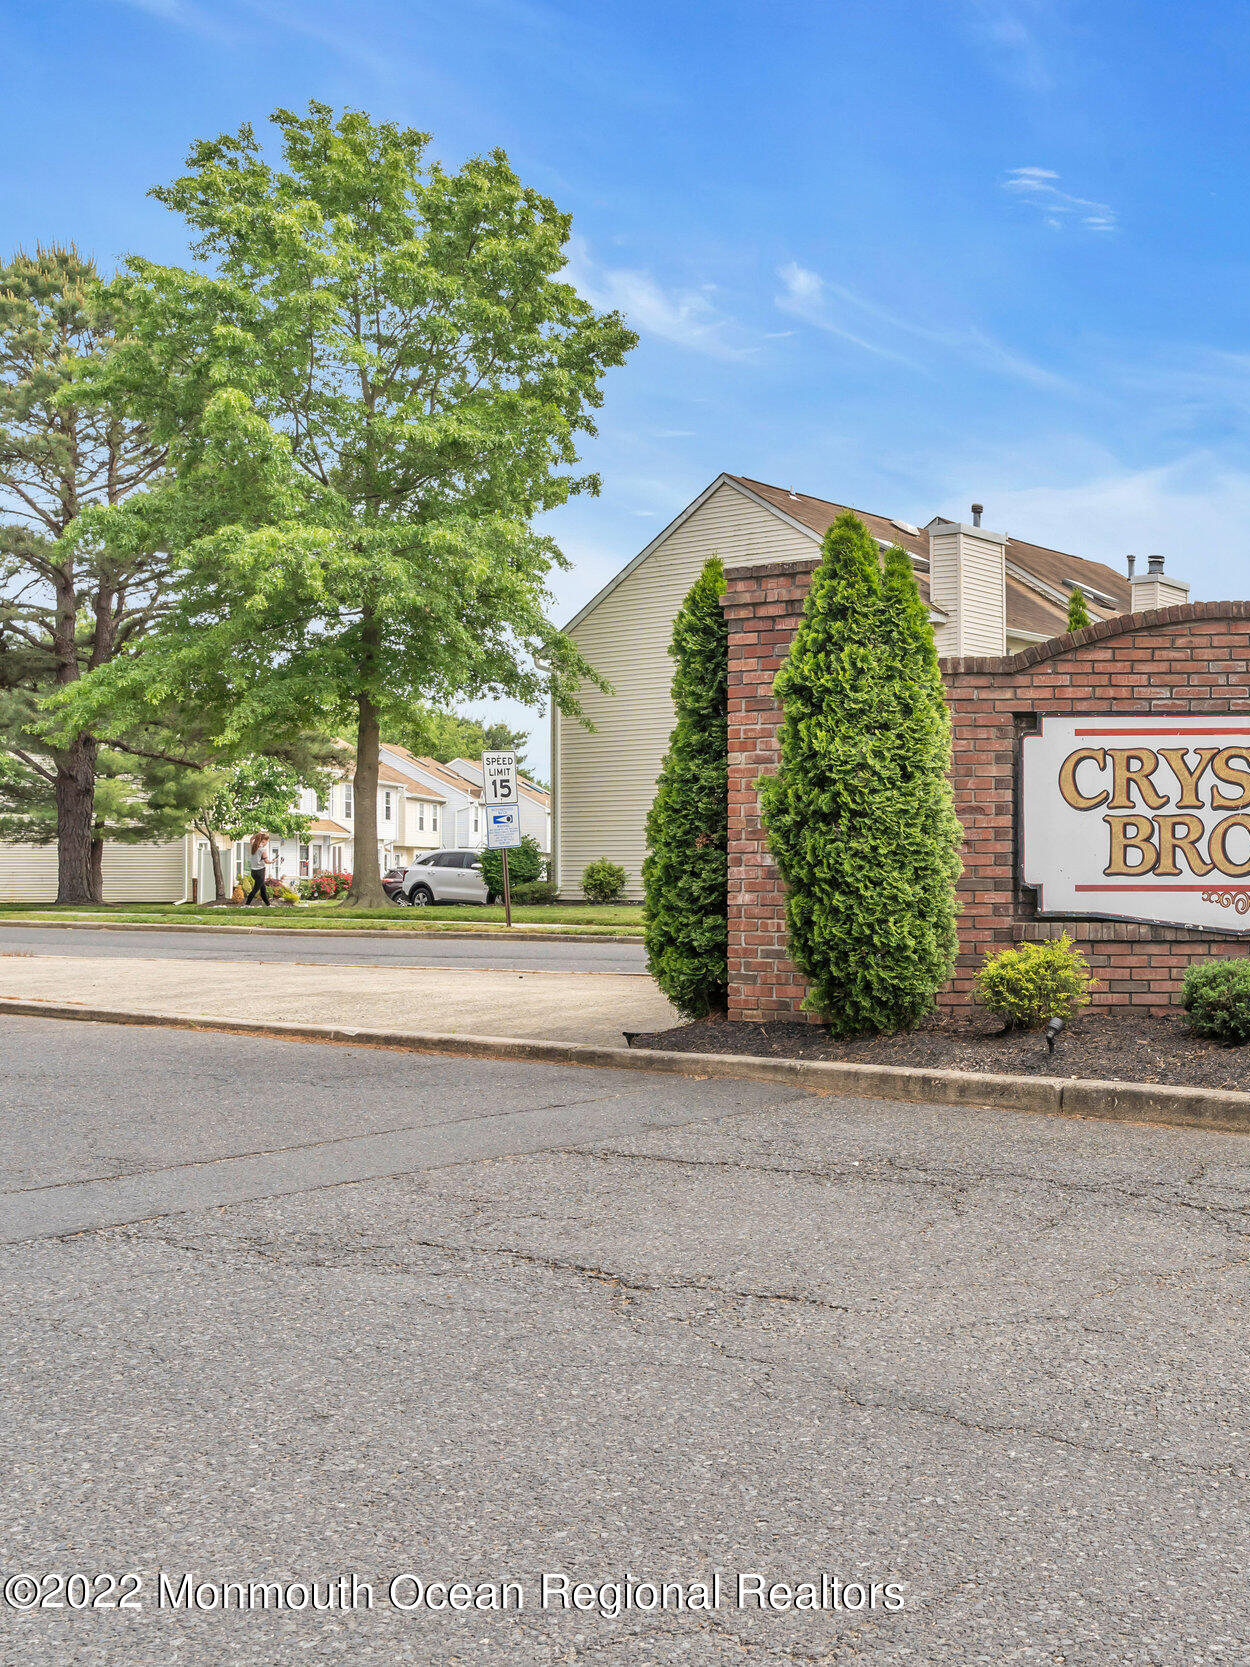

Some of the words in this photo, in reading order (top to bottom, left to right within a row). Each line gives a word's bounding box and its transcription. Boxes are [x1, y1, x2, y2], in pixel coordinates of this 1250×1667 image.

[486, 757, 513, 766] SPEED
[489, 768, 511, 776] LIMIT
[492, 779, 512, 798] 15
